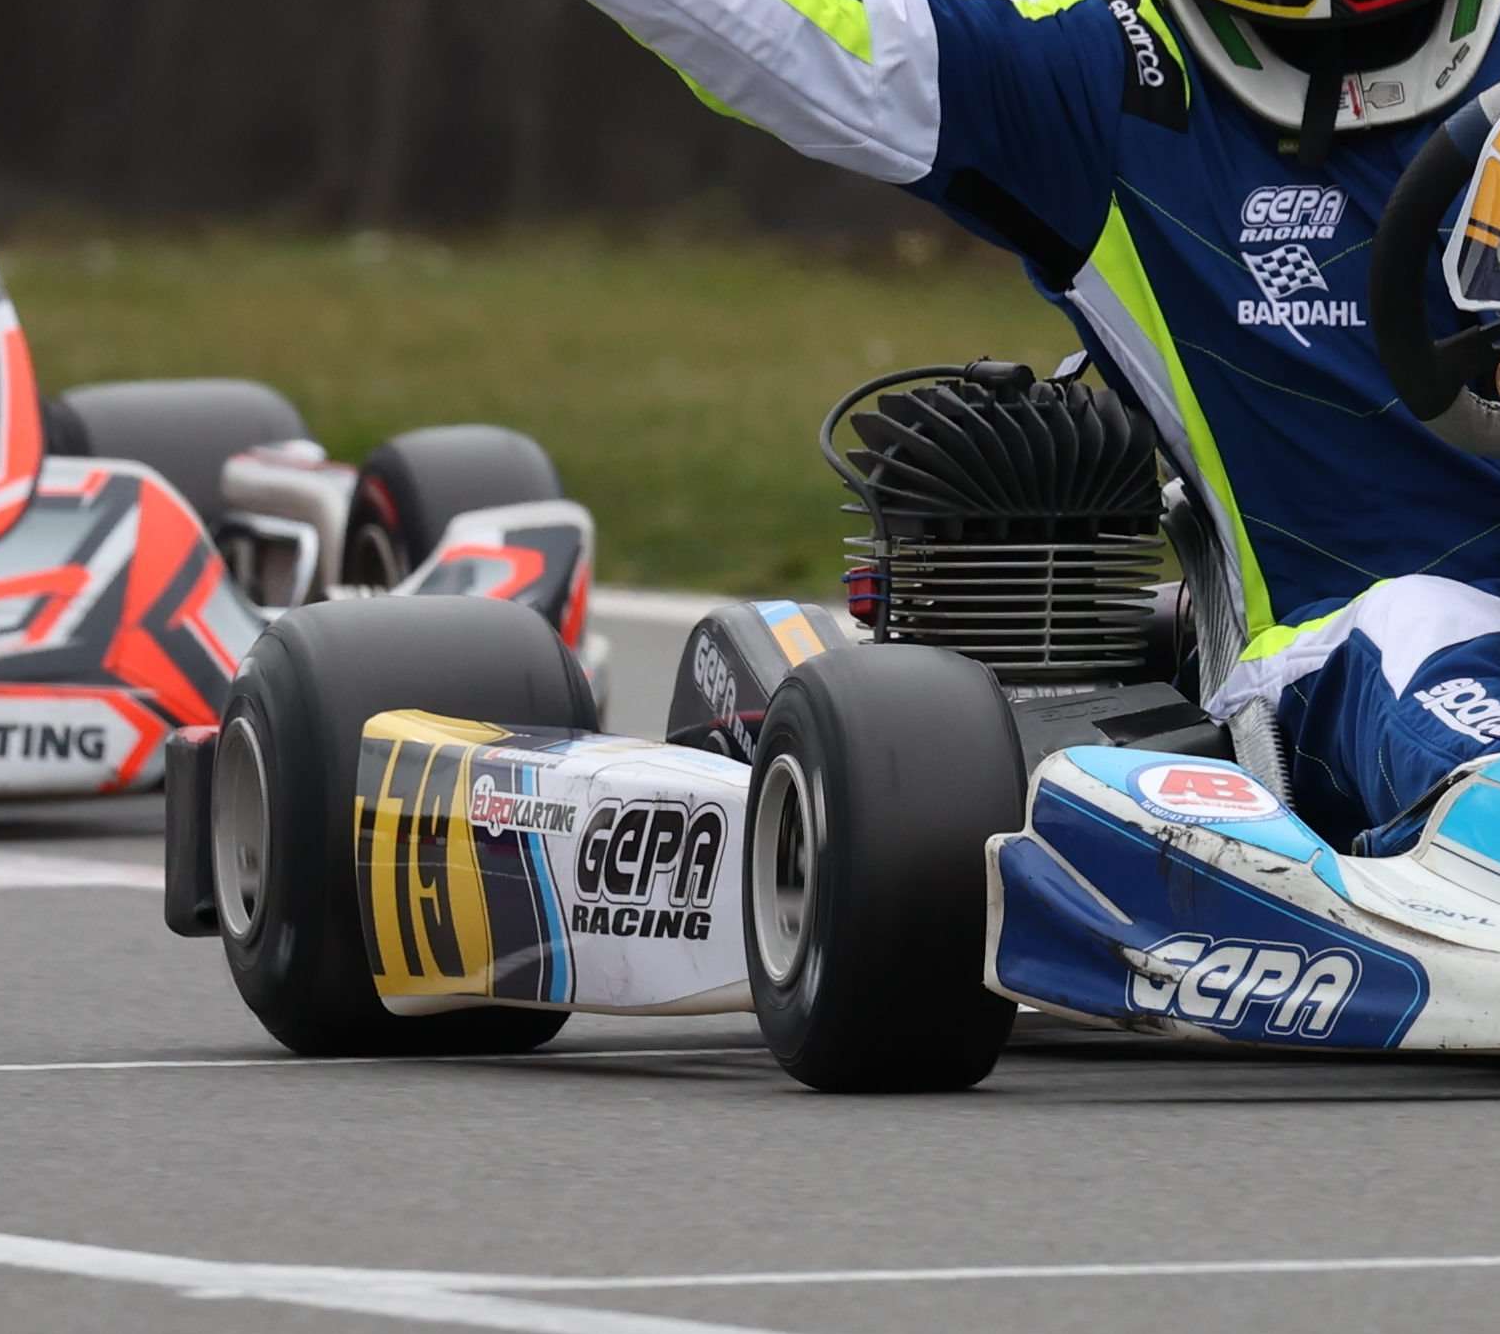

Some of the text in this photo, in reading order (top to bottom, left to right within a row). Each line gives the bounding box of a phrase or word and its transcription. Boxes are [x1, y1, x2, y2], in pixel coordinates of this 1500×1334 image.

[1243, 187, 1347, 226] GEPA
[1239, 225, 1337, 243] RACING
[1237, 299, 1367, 329] BARDAHL
[1158, 769, 1259, 803] AB
[471, 793, 577, 833] EUROKARTING
[575, 800, 725, 906] GEPA
[572, 905, 712, 940] RACING
[1129, 936, 1359, 1035] GEPA
